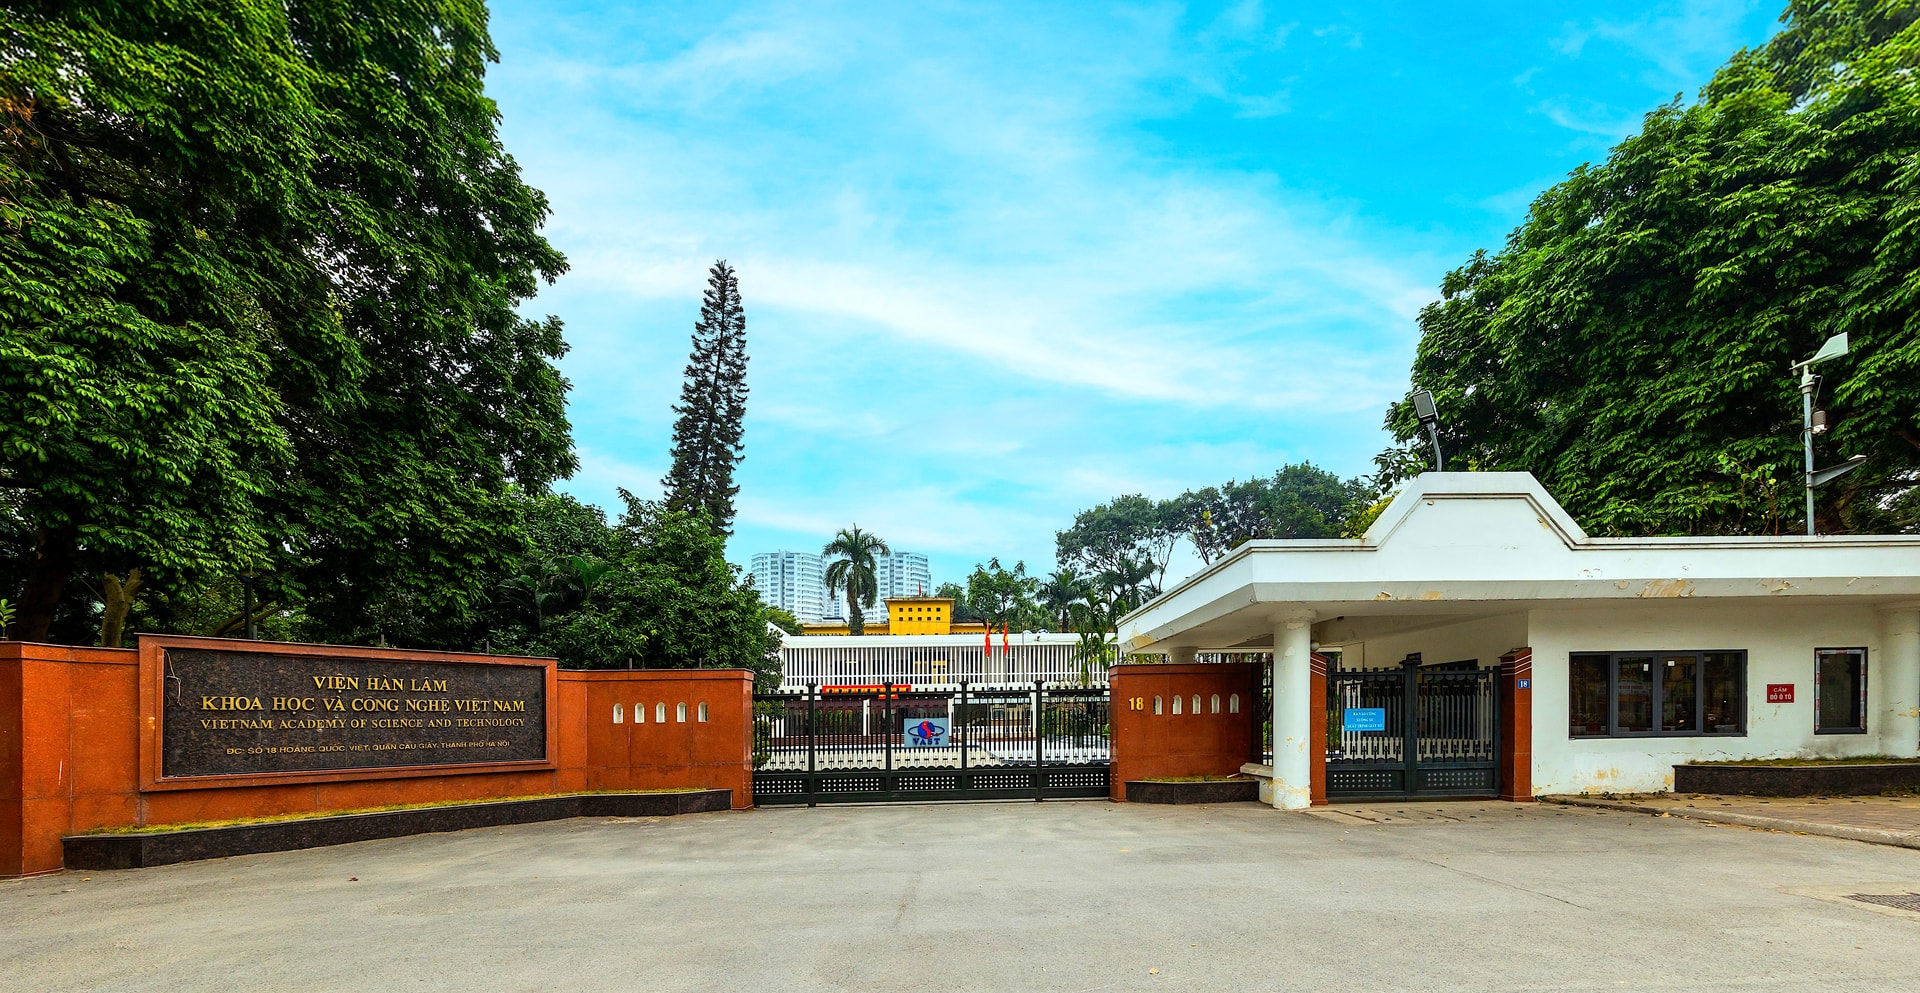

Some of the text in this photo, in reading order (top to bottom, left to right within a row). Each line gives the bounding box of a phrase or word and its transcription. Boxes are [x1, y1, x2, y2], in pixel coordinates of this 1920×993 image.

[313, 673, 448, 693] VIỆN HÀN LÂM
[1520, 680, 1528, 688] 18
[200, 695, 526, 715] KHOA HỌC VÀ CÔNG NGHỆ VIỆT NAM
[1128, 696, 1145, 711] 18
[200, 718, 526, 729] VIETNAM ACADEMY OF SCIENCE AND TECHNOLOGY
[912, 737, 941, 746] VAST
